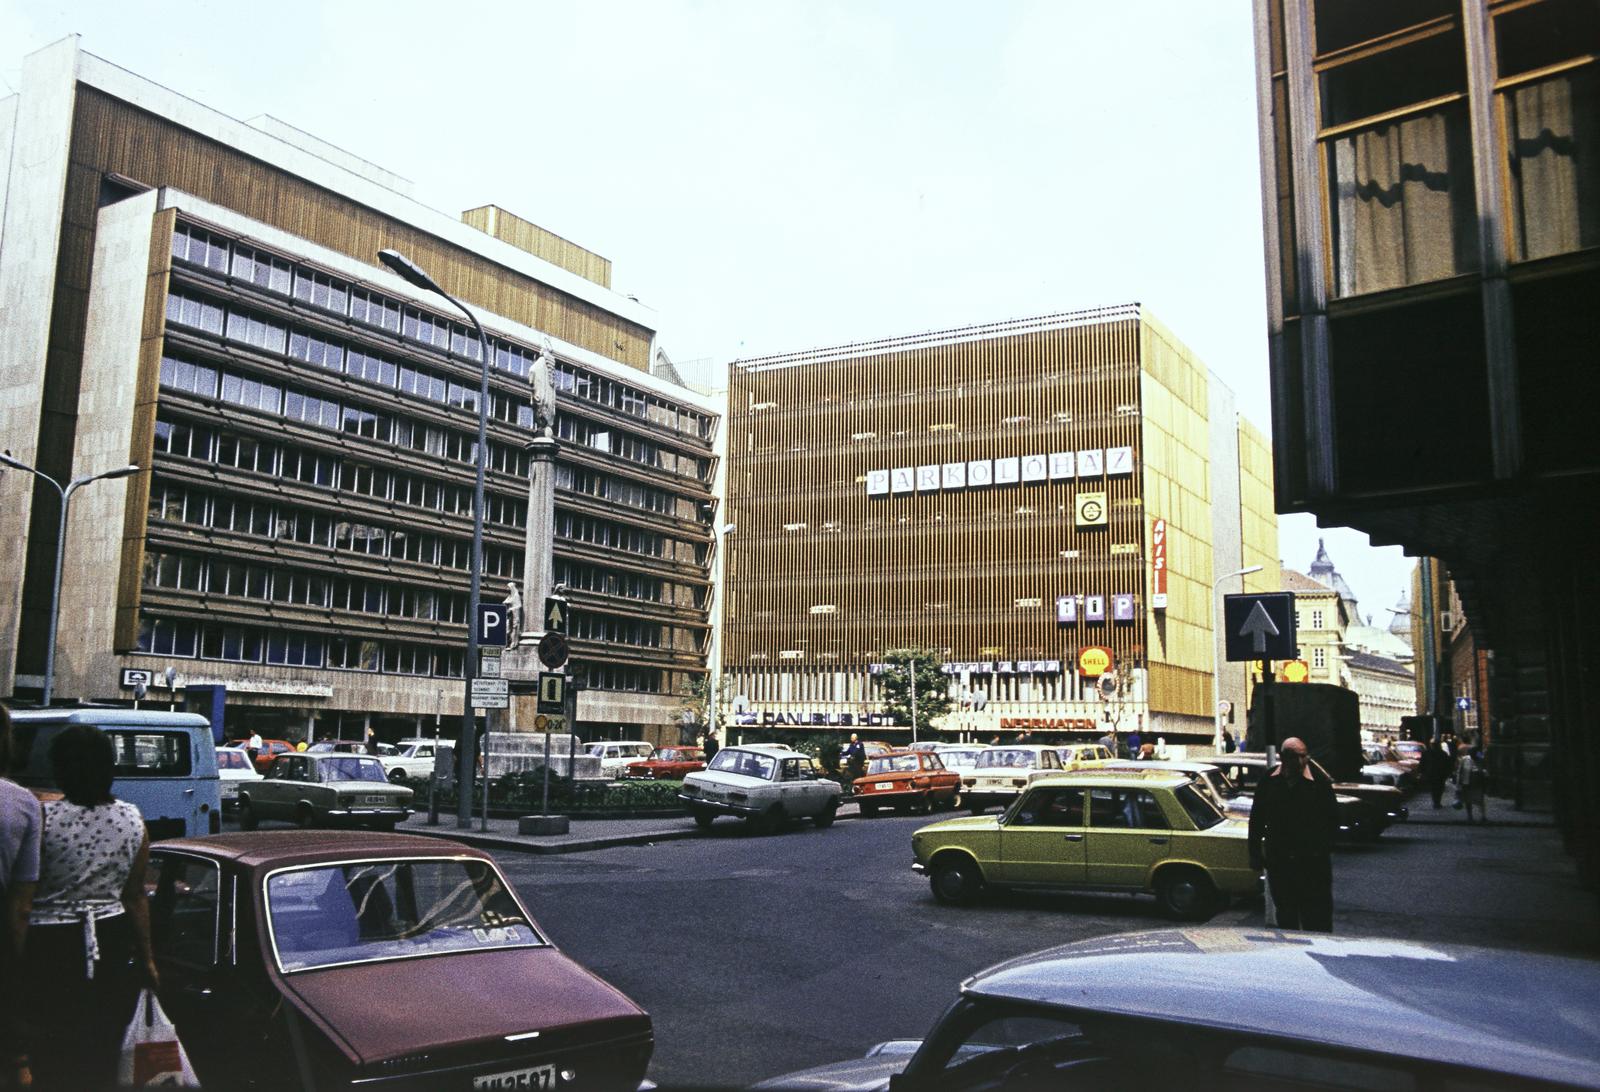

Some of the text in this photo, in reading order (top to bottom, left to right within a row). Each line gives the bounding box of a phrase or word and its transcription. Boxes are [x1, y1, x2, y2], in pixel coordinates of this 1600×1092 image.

[871, 450, 1128, 491] PARKOLÓHÁZ
[1153, 520, 1165, 570] AVIS
[483, 611, 500, 638] P
[999, 662, 1011, 673] A
[1018, 661, 1059, 673] CAR
[763, 712, 852, 726] DANUBIUS
[1000, 718, 1097, 729] INFORMATION
